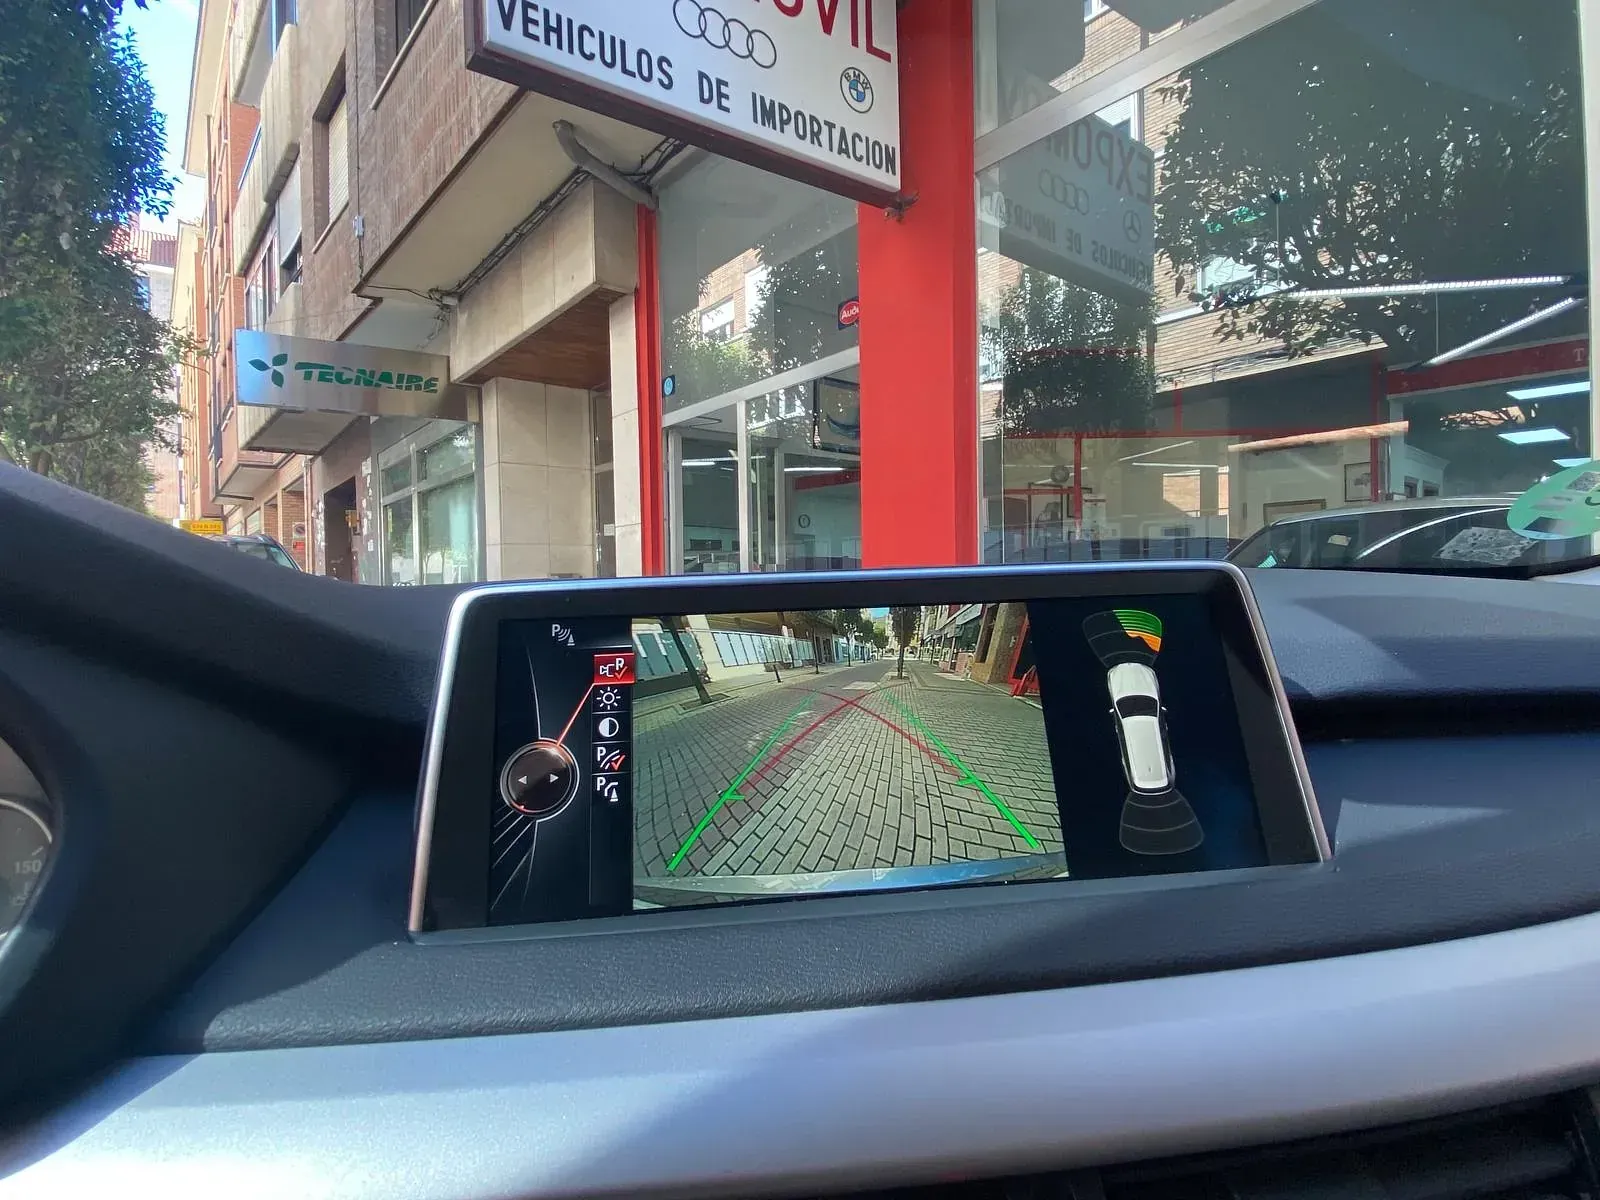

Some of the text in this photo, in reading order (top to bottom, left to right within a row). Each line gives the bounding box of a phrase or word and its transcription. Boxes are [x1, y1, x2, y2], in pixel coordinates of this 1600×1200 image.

[488, 0, 897, 177] VEHICULOS DE IMPORTACION
[844, 70, 869, 90] BMW
[294, 361, 439, 394] TECNAIRE
[14, 859, 42, 875] 150
